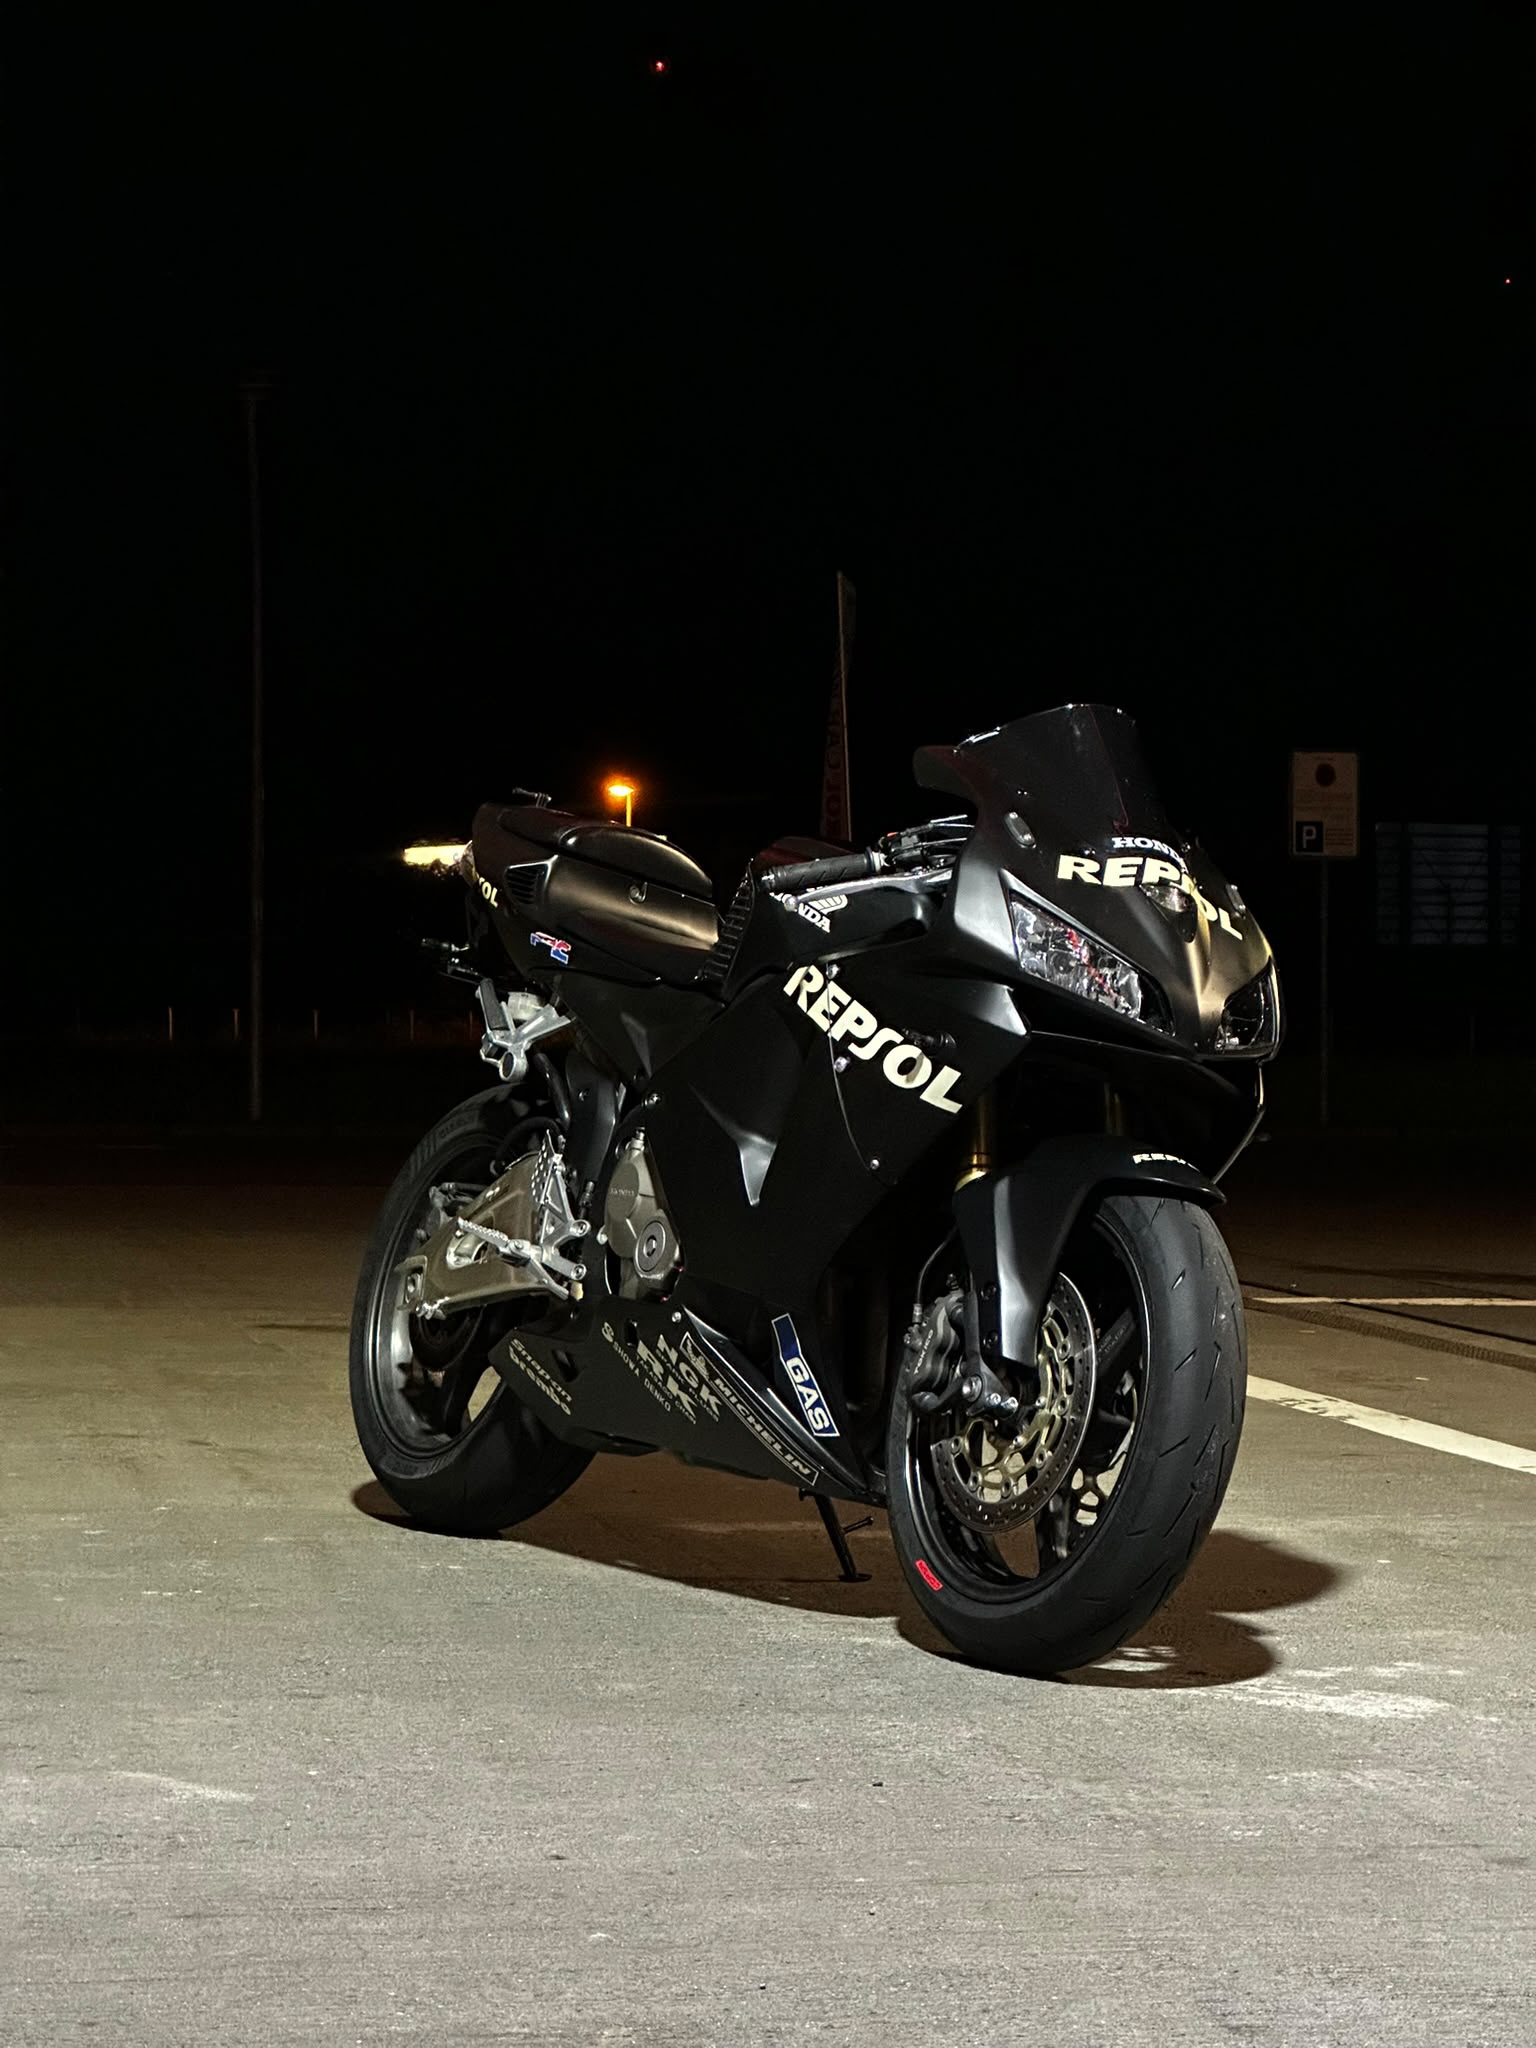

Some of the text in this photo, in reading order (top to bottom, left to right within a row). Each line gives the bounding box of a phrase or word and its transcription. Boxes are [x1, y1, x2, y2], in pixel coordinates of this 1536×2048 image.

[1111, 836, 1189, 874] HONDA
[1302, 825, 1318, 849] P
[1057, 854, 1243, 941] REPSOL
[783, 965, 963, 1114] REPSOL
[637, 1340, 698, 1419] RK
[656, 1334, 722, 1417] NGK
[786, 1357, 830, 1431] GAS
[714, 1378, 811, 1475] MICHELIN
